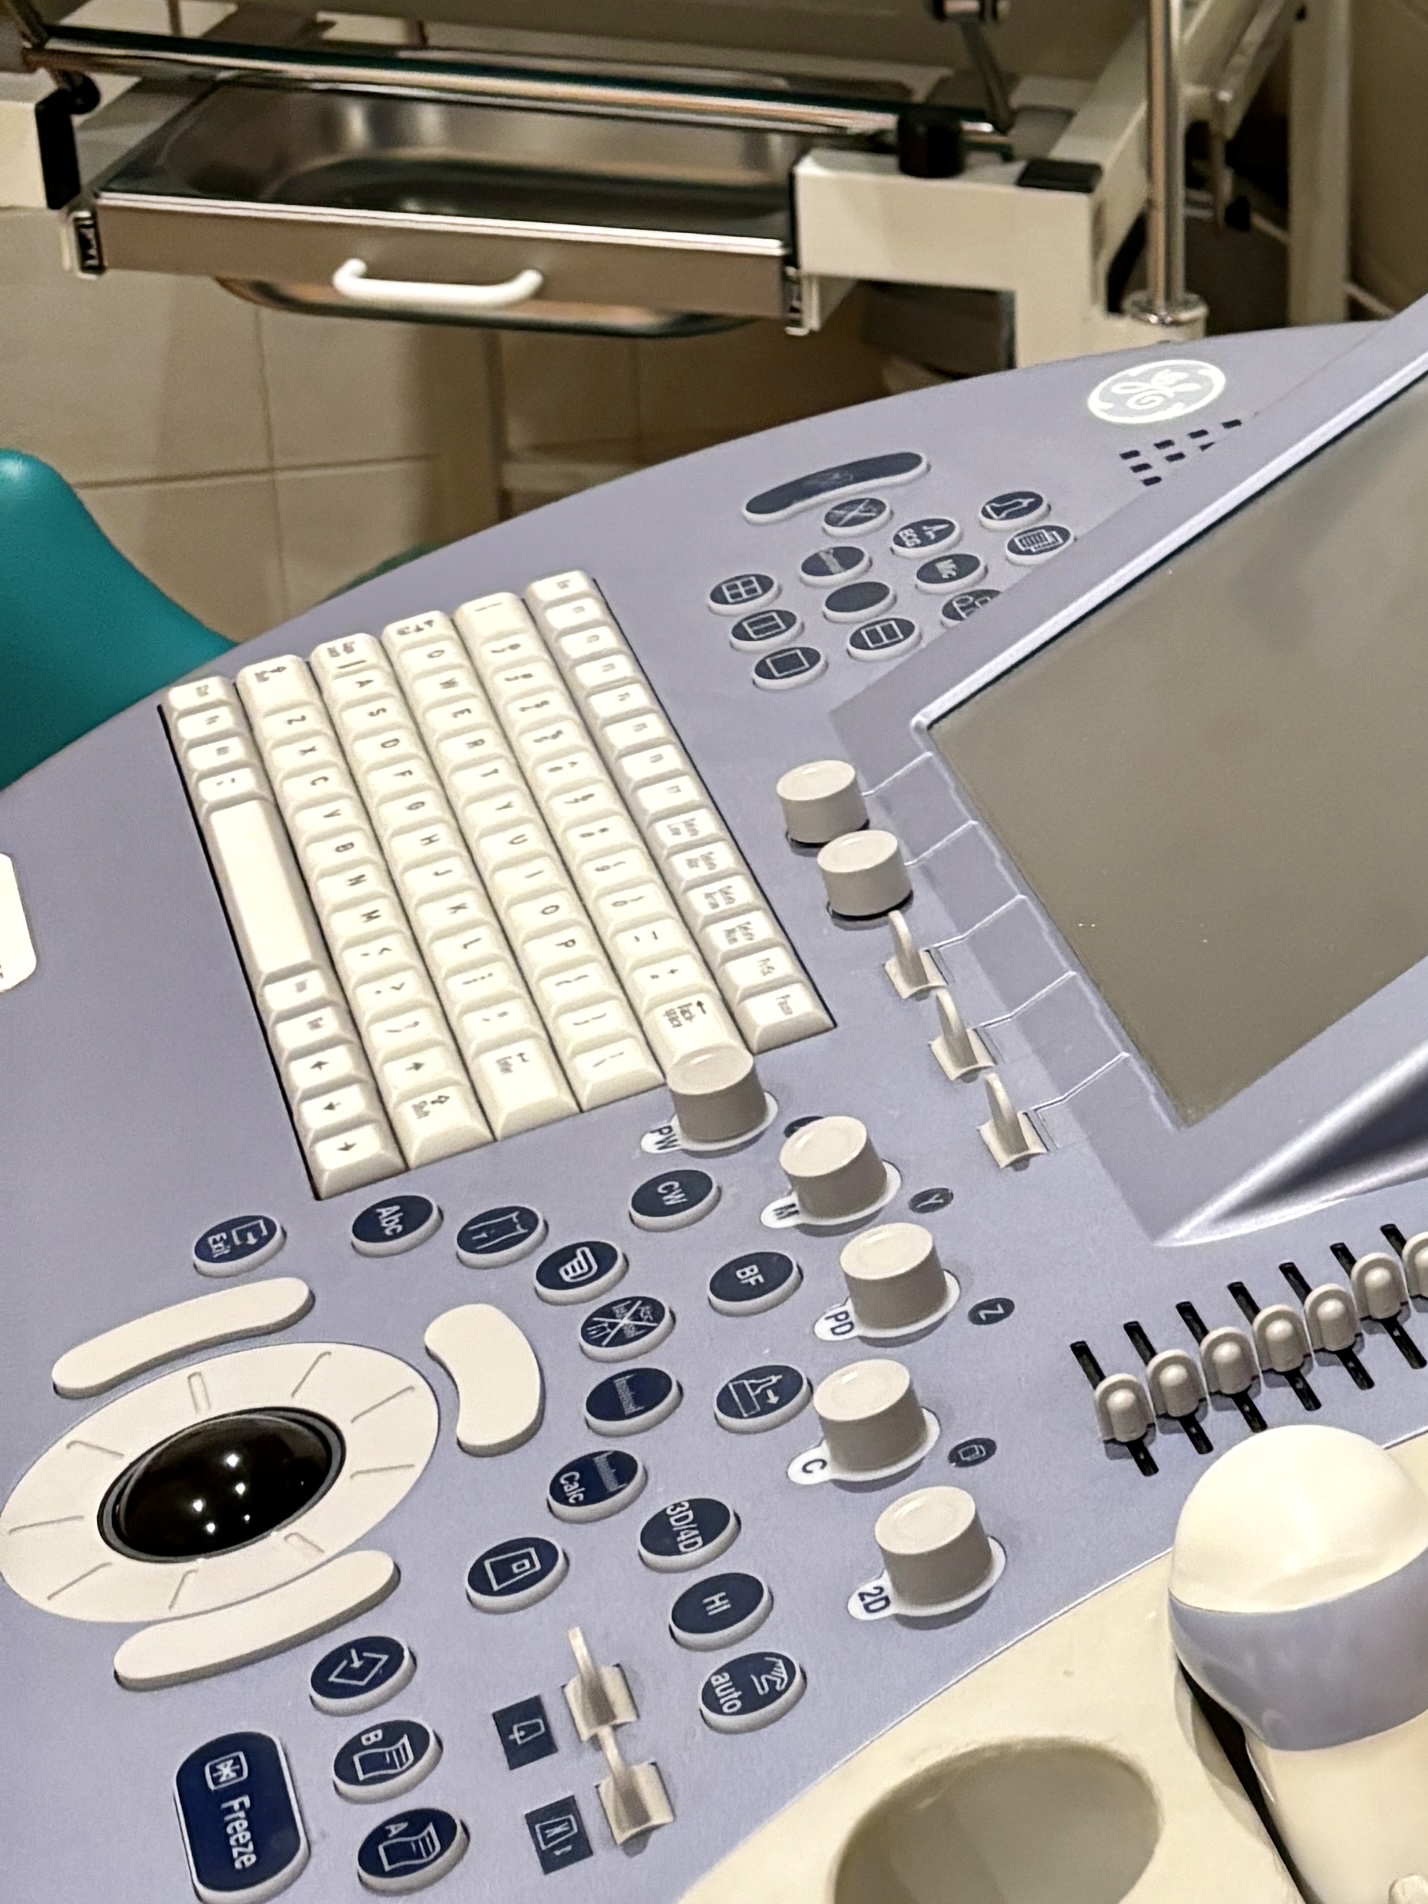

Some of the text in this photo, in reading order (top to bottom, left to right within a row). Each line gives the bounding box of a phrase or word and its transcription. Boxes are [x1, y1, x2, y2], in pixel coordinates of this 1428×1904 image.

[899, 528, 921, 547] ECG
[355, 679, 374, 688] A
[367, 707, 388, 718] S
[452, 707, 472, 719] E
[286, 714, 307, 726] Z
[380, 737, 401, 749] D
[466, 738, 486, 749] R
[299, 745, 317, 756] X
[394, 769, 414, 777] F
[480, 767, 500, 778] T
[310, 775, 330, 787] C
[406, 800, 426, 811] G
[495, 801, 513, 811] Y
[323, 808, 342, 819] V
[420, 833, 440, 846] H
[508, 833, 529, 846] U
[334, 841, 355, 853] B
[433, 869, 453, 877] J
[347, 873, 366, 887] N
[448, 902, 468, 914] K
[540, 904, 560, 916] O
[361, 909, 382, 923] M
[461, 937, 482, 950] L
[556, 938, 577, 948] P
[651, 1125, 681, 1151] PW
[657, 1181, 688, 1206] CW
[917, 1194, 944, 1208] Y
[377, 1205, 403, 1235] Abc
[208, 1233, 230, 1258] Exit
[736, 1265, 764, 1286] BF
[979, 1304, 1005, 1321] Z
[825, 1311, 855, 1336] PD
[802, 1459, 827, 1474] C
[560, 1472, 586, 1503] Calc
[667, 1502, 703, 1552] 3D/4D
[703, 1592, 731, 1616] HI
[858, 1586, 892, 1614] 2D
[711, 1672, 743, 1714] auto
[361, 1729, 383, 1746] B
[222, 1795, 257, 1870] Freeze
[386, 1822, 408, 1838] A
